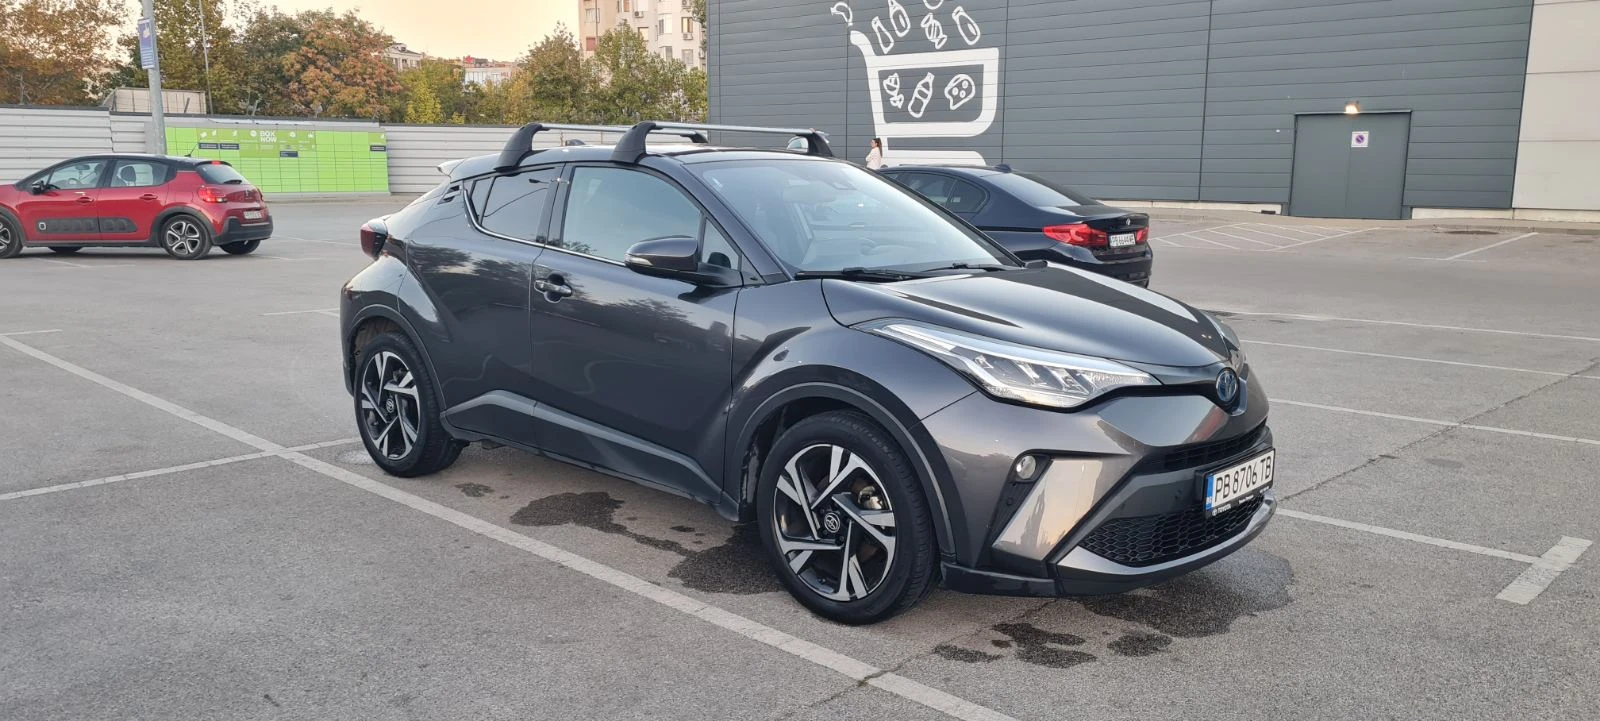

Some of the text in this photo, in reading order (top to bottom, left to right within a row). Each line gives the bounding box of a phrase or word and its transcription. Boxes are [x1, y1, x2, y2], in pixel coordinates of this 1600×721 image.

[1215, 456, 1271, 502] PB 8706 TB
[1217, 504, 1231, 514] TOYOTA
